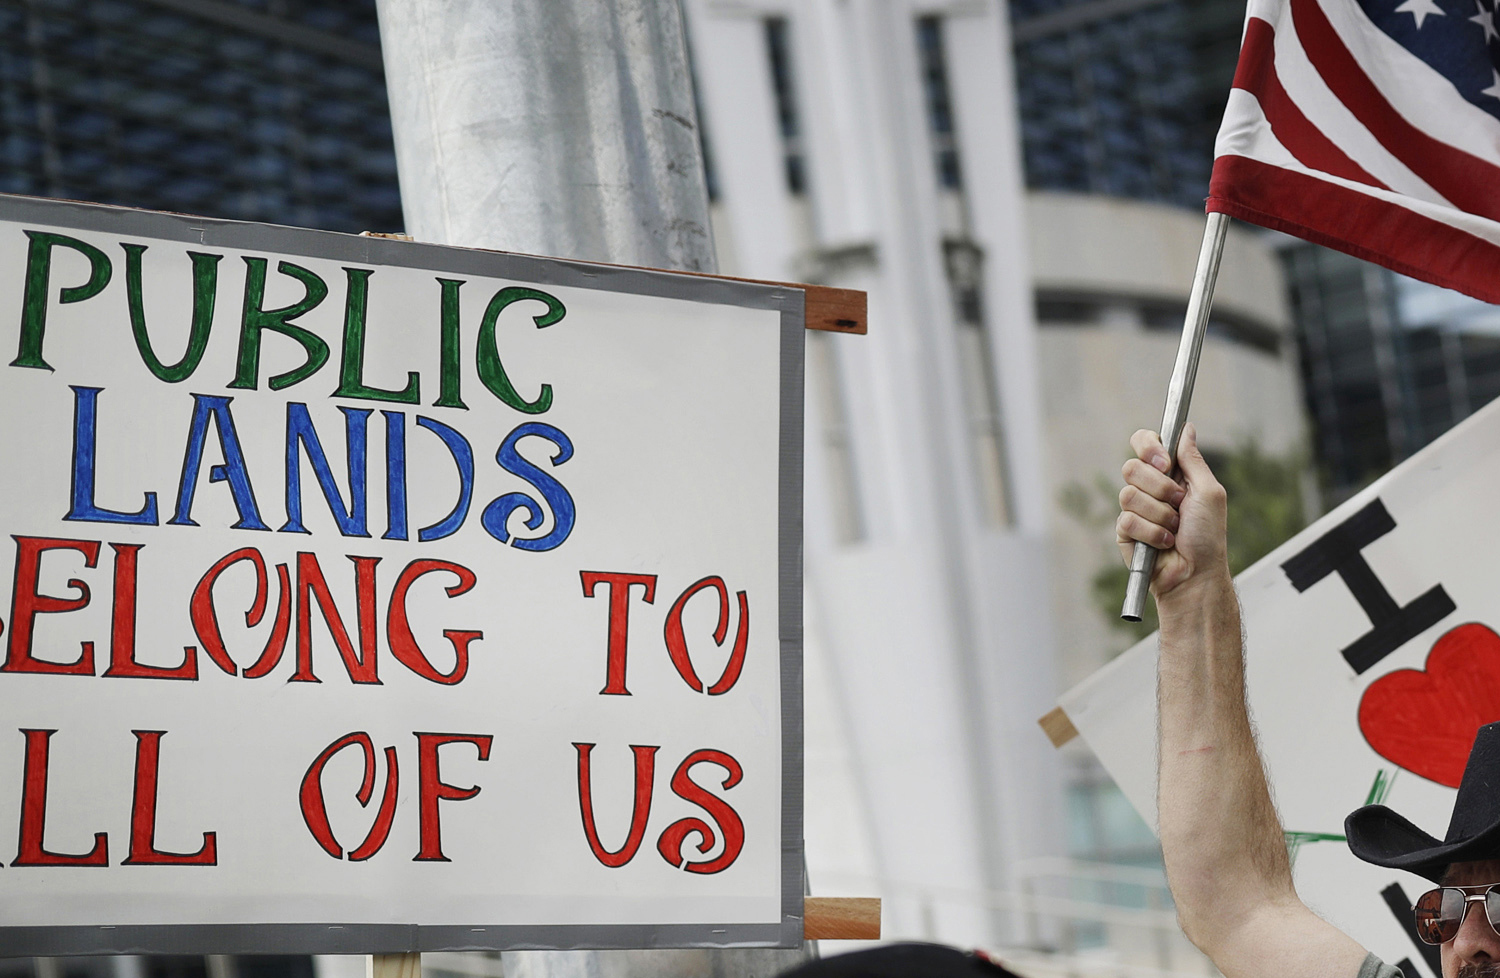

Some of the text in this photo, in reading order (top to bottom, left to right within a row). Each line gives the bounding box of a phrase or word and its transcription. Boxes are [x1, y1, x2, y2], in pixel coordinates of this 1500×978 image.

[8, 229, 567, 414] PUBLIC
[62, 384, 577, 551] LANDS
[0, 534, 750, 697] ELONG TO
[1279, 495, 1459, 677] I
[0, 728, 745, 875] LL OF US
